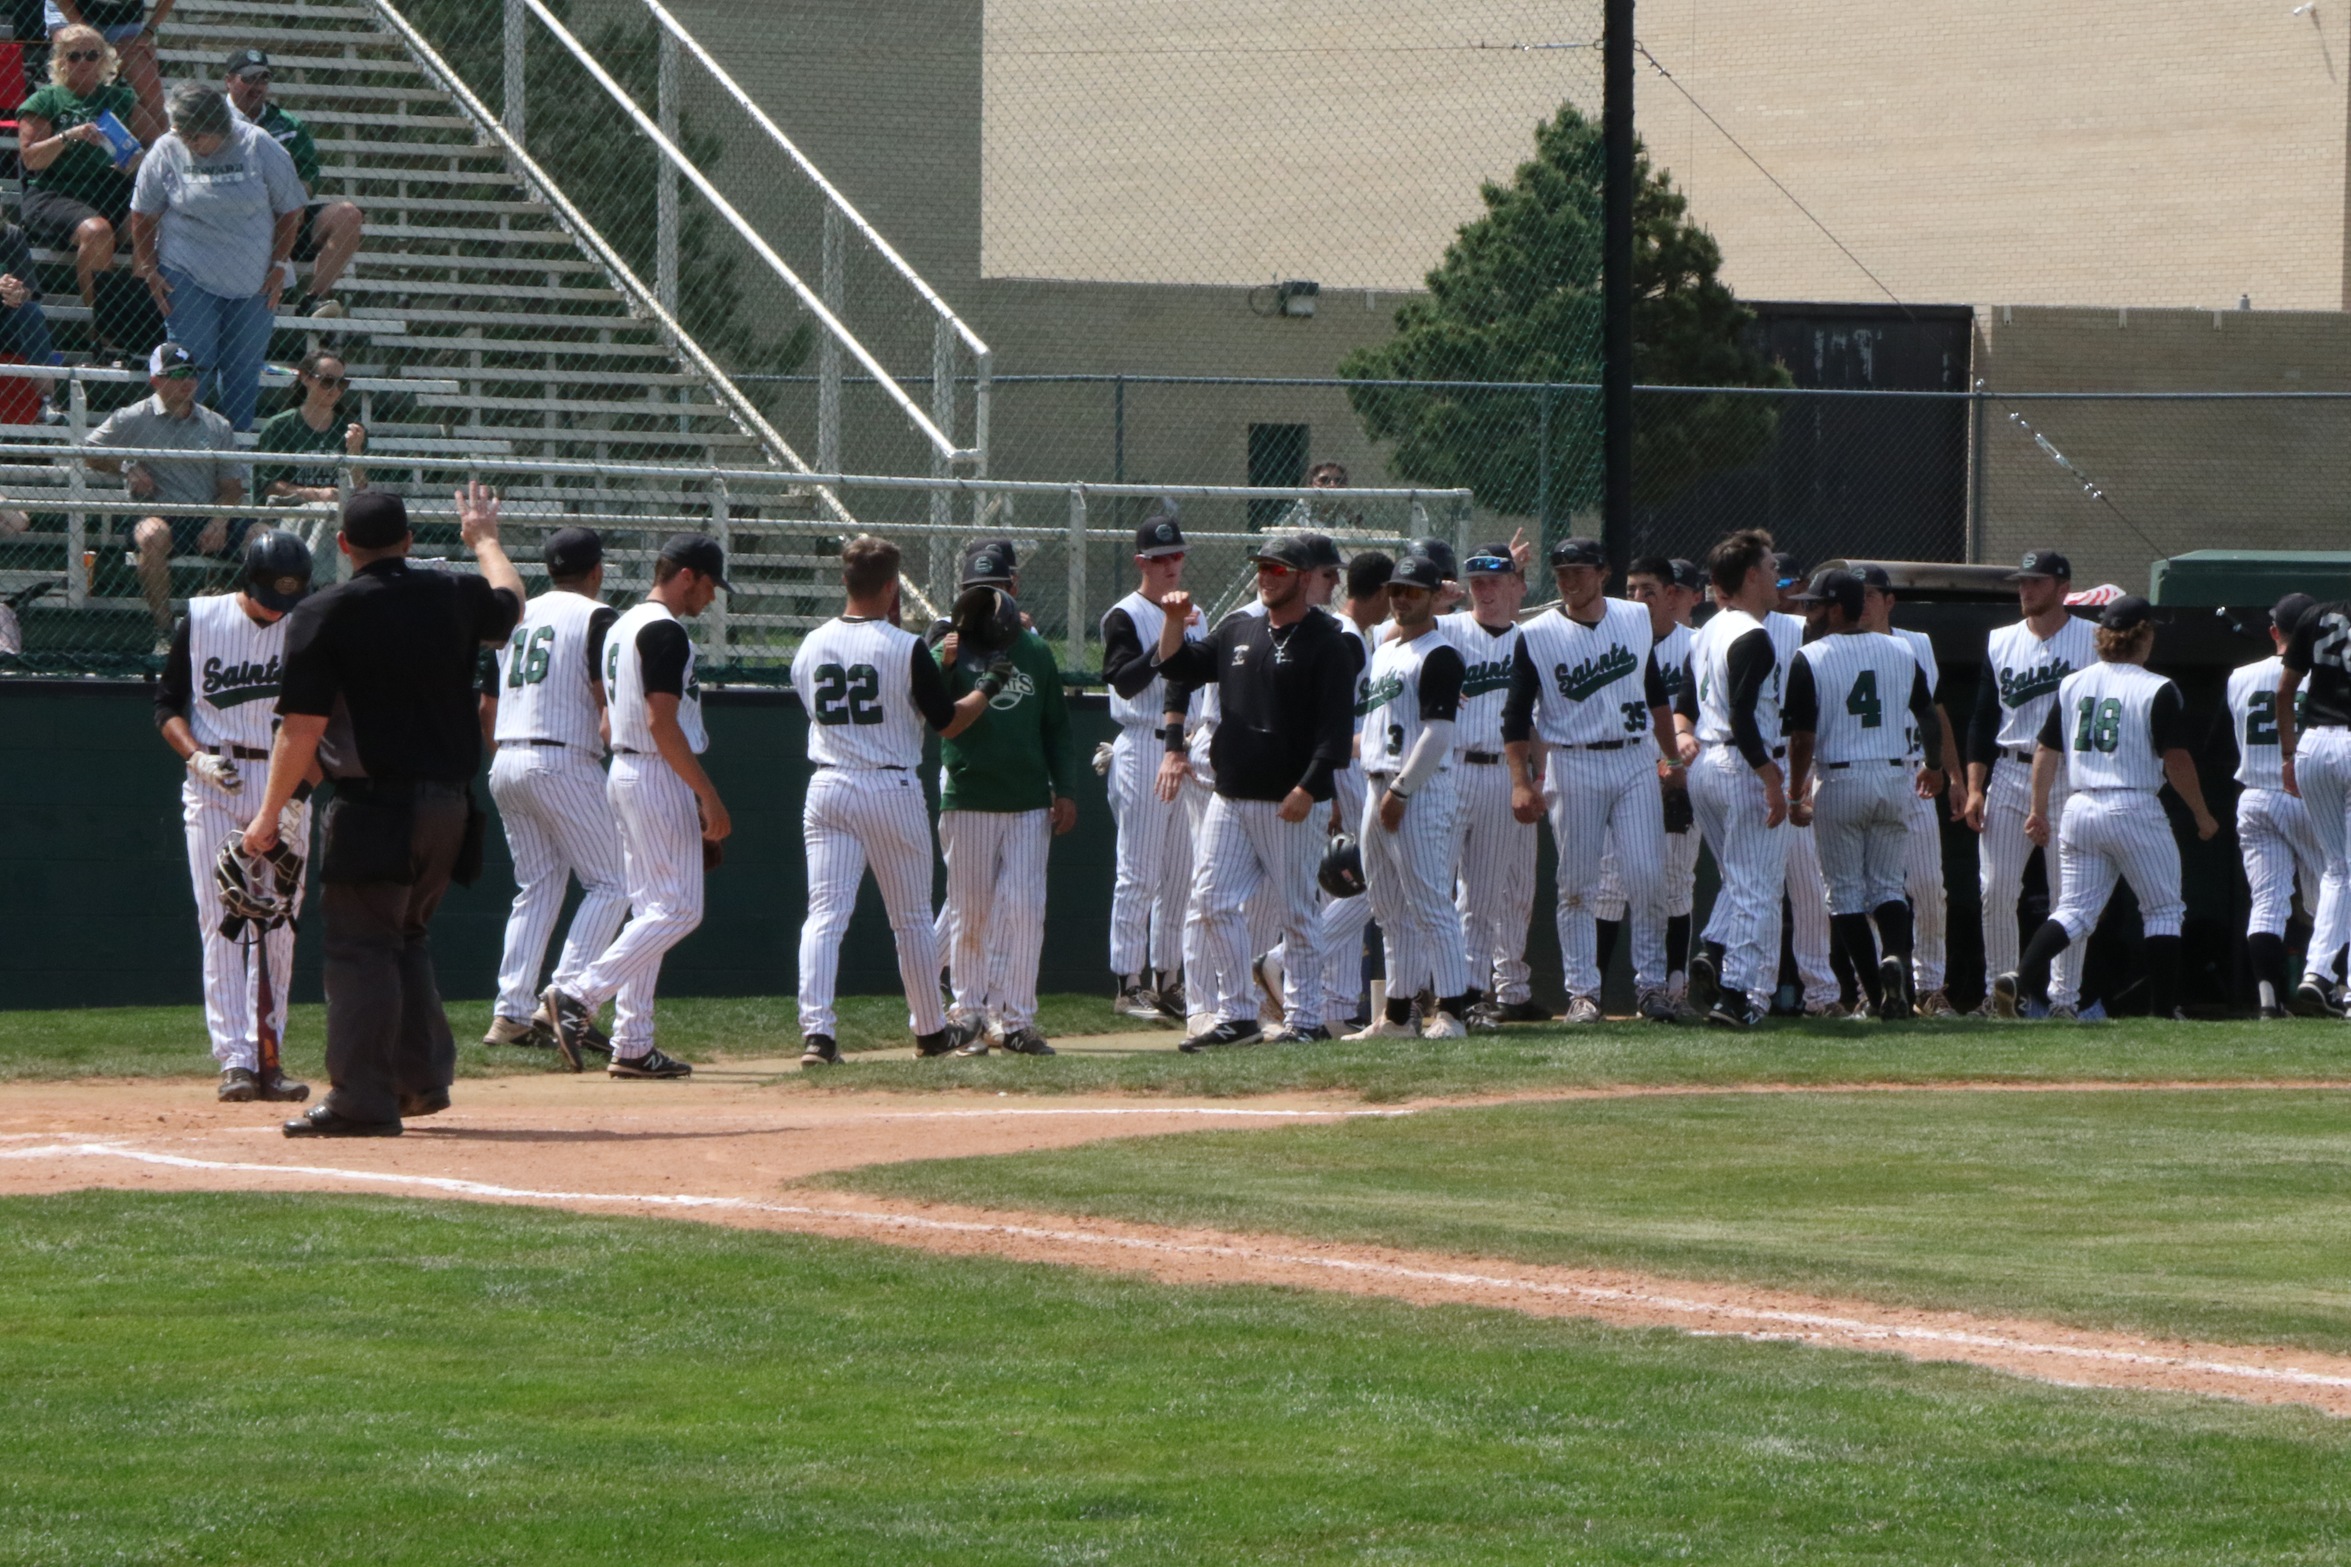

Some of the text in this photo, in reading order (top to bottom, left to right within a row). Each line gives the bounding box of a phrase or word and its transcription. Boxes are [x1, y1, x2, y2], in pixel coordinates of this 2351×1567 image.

[508, 625, 555, 688] 16
[1555, 642, 1630, 693] Saints
[814, 663, 883, 726] 22
[1621, 700, 1647, 732] 35
[1845, 670, 1882, 729] 4
[1387, 724, 1404, 757] 3
[2074, 696, 2122, 753] 18
